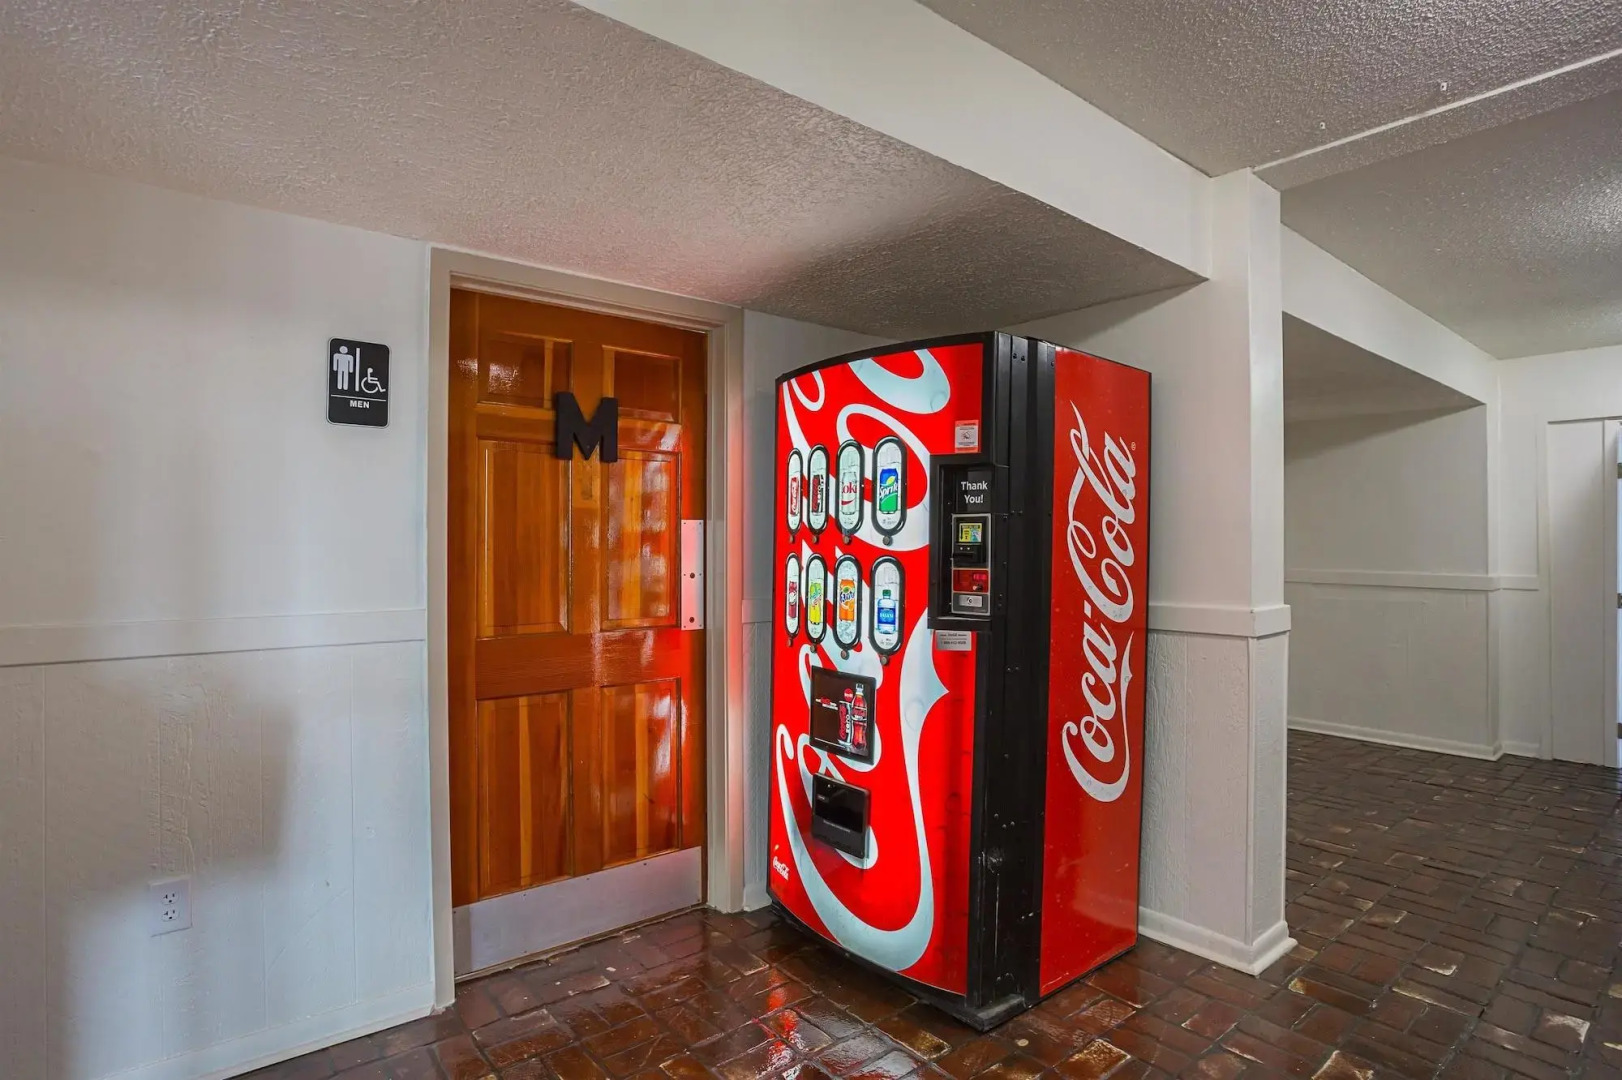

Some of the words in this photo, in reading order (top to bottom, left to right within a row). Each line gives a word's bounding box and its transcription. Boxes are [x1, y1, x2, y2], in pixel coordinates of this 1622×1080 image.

[350, 400, 370, 409] MEN
[555, 391, 618, 463] M
[961, 480, 988, 491] Thank
[964, 494, 984, 504] You!
[1062, 400, 1136, 802] Coca-Cola
